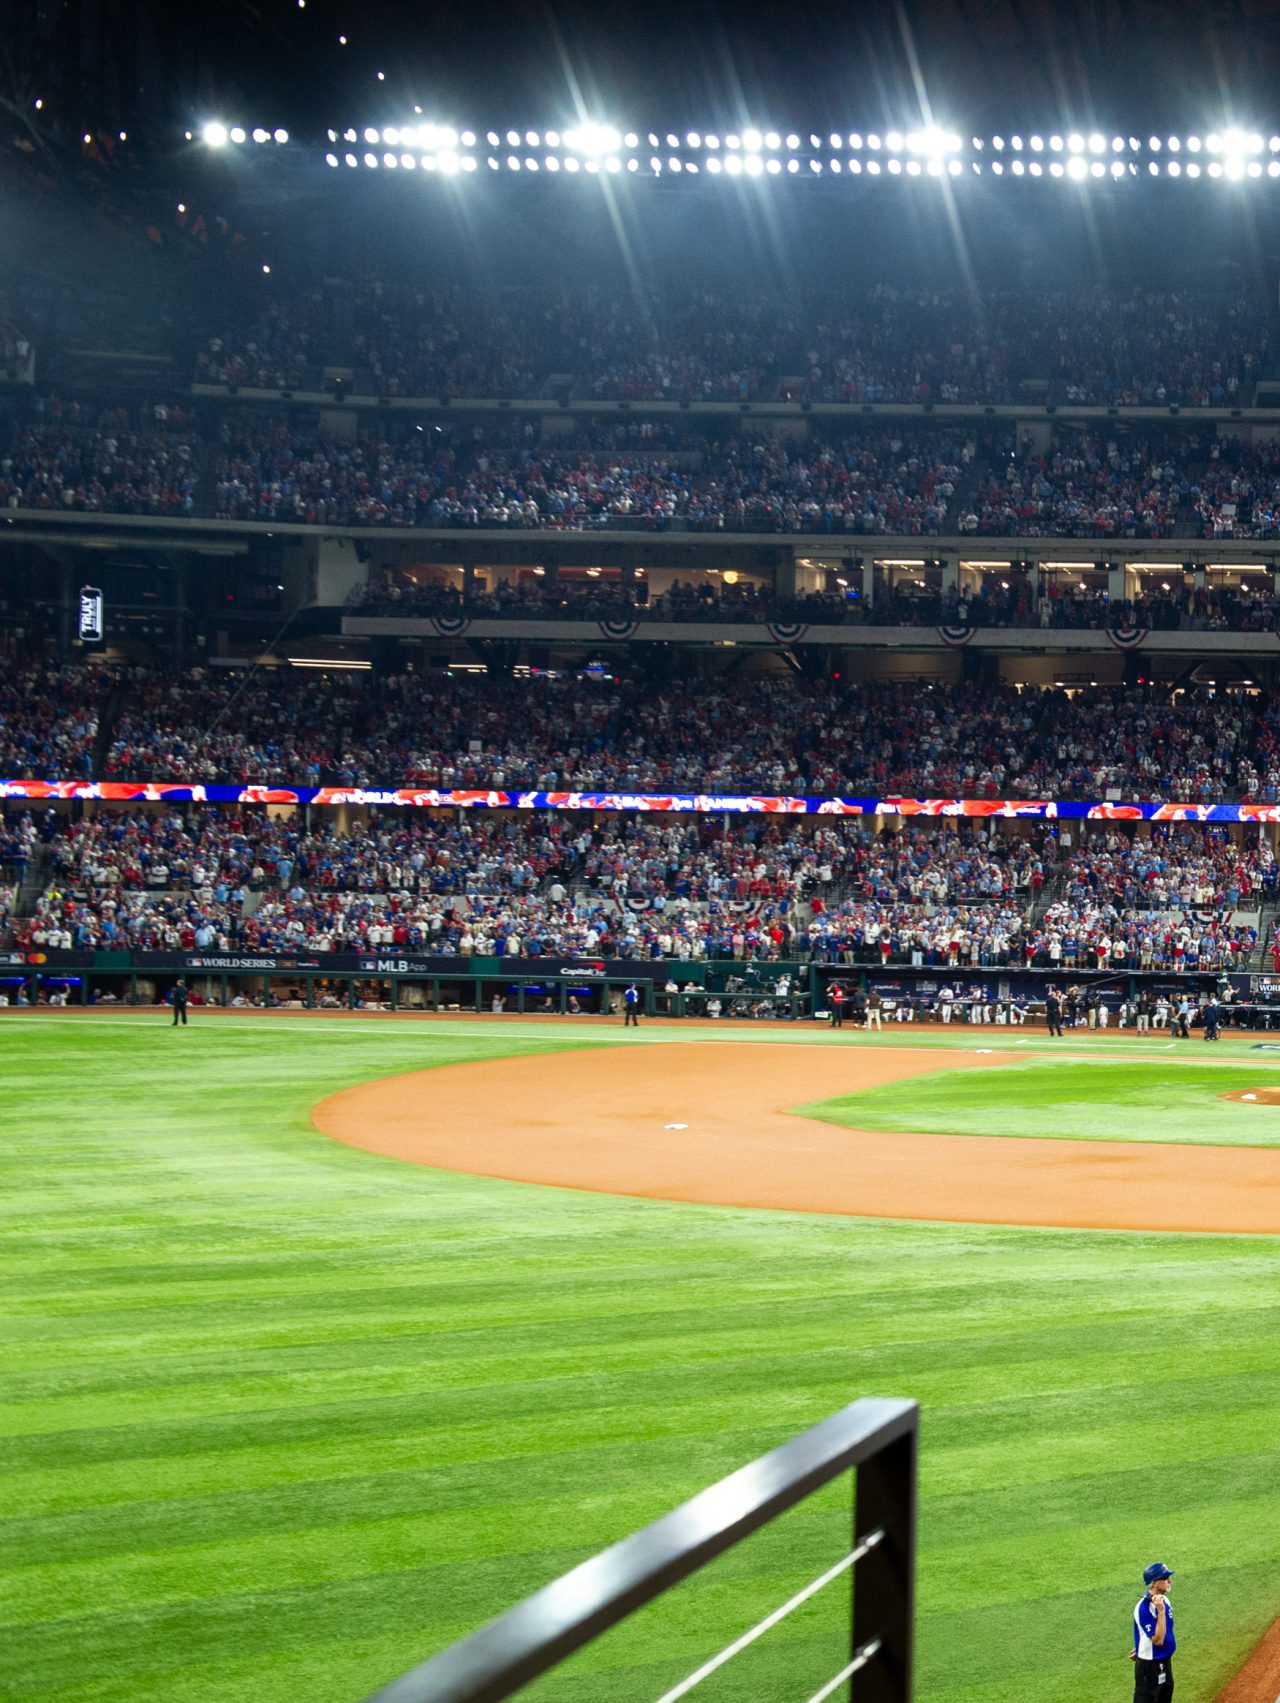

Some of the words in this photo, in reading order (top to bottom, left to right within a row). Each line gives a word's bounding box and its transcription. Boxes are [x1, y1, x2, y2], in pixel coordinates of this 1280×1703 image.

[82, 595, 93, 632] TRULY
[202, 958, 241, 968] WORLD
[240, 959, 277, 969] SERIES
[378, 960, 408, 972] MLB
[409, 963, 427, 973] App
